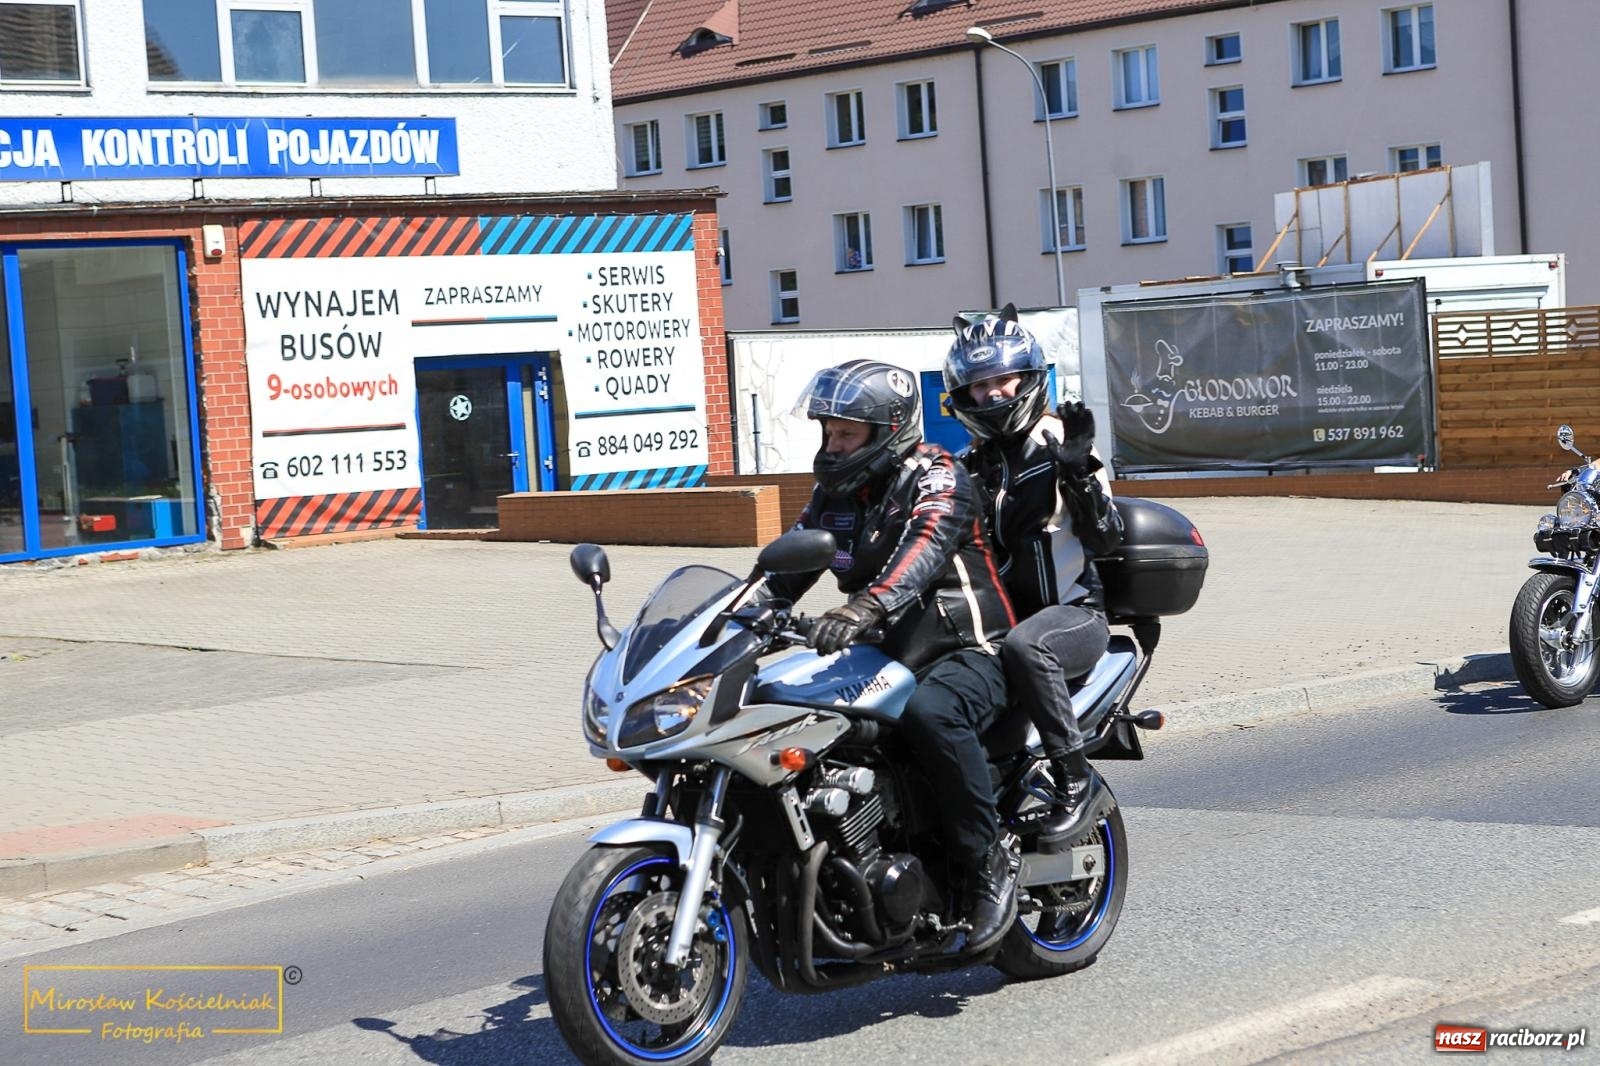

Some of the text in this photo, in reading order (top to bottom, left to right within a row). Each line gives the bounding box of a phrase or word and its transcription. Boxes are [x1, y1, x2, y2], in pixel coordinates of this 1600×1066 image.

[82, 127, 249, 167] KONTROLI
[268, 122, 440, 165] POJAZDÓW
[598, 265, 665, 287] SERWIS
[256, 289, 399, 318] WYNAJEM
[424, 284, 542, 305] ZAPRASZAMY
[592, 292, 673, 314] SKUTERY
[578, 318, 690, 343] MOTOROWERY
[1305, 312, 1405, 333] ZAPRASZAMY!
[281, 323, 382, 361] BUSÓW
[1373, 346, 1402, 357] sobota
[598, 346, 675, 369] ROWERY
[1315, 360, 1339, 371] 11.00
[1345, 359, 1369, 370] 23.00
[267, 374, 398, 401] 9-osobowych
[606, 374, 670, 400] QUADY
[1189, 404, 1280, 419] KEBAB & BURGER
[598, 429, 698, 456] 884 049 292
[1328, 425, 1405, 441] 537 891 962
[287, 449, 407, 477] 602 111 553
[835, 675, 893, 703] YAMAHA
